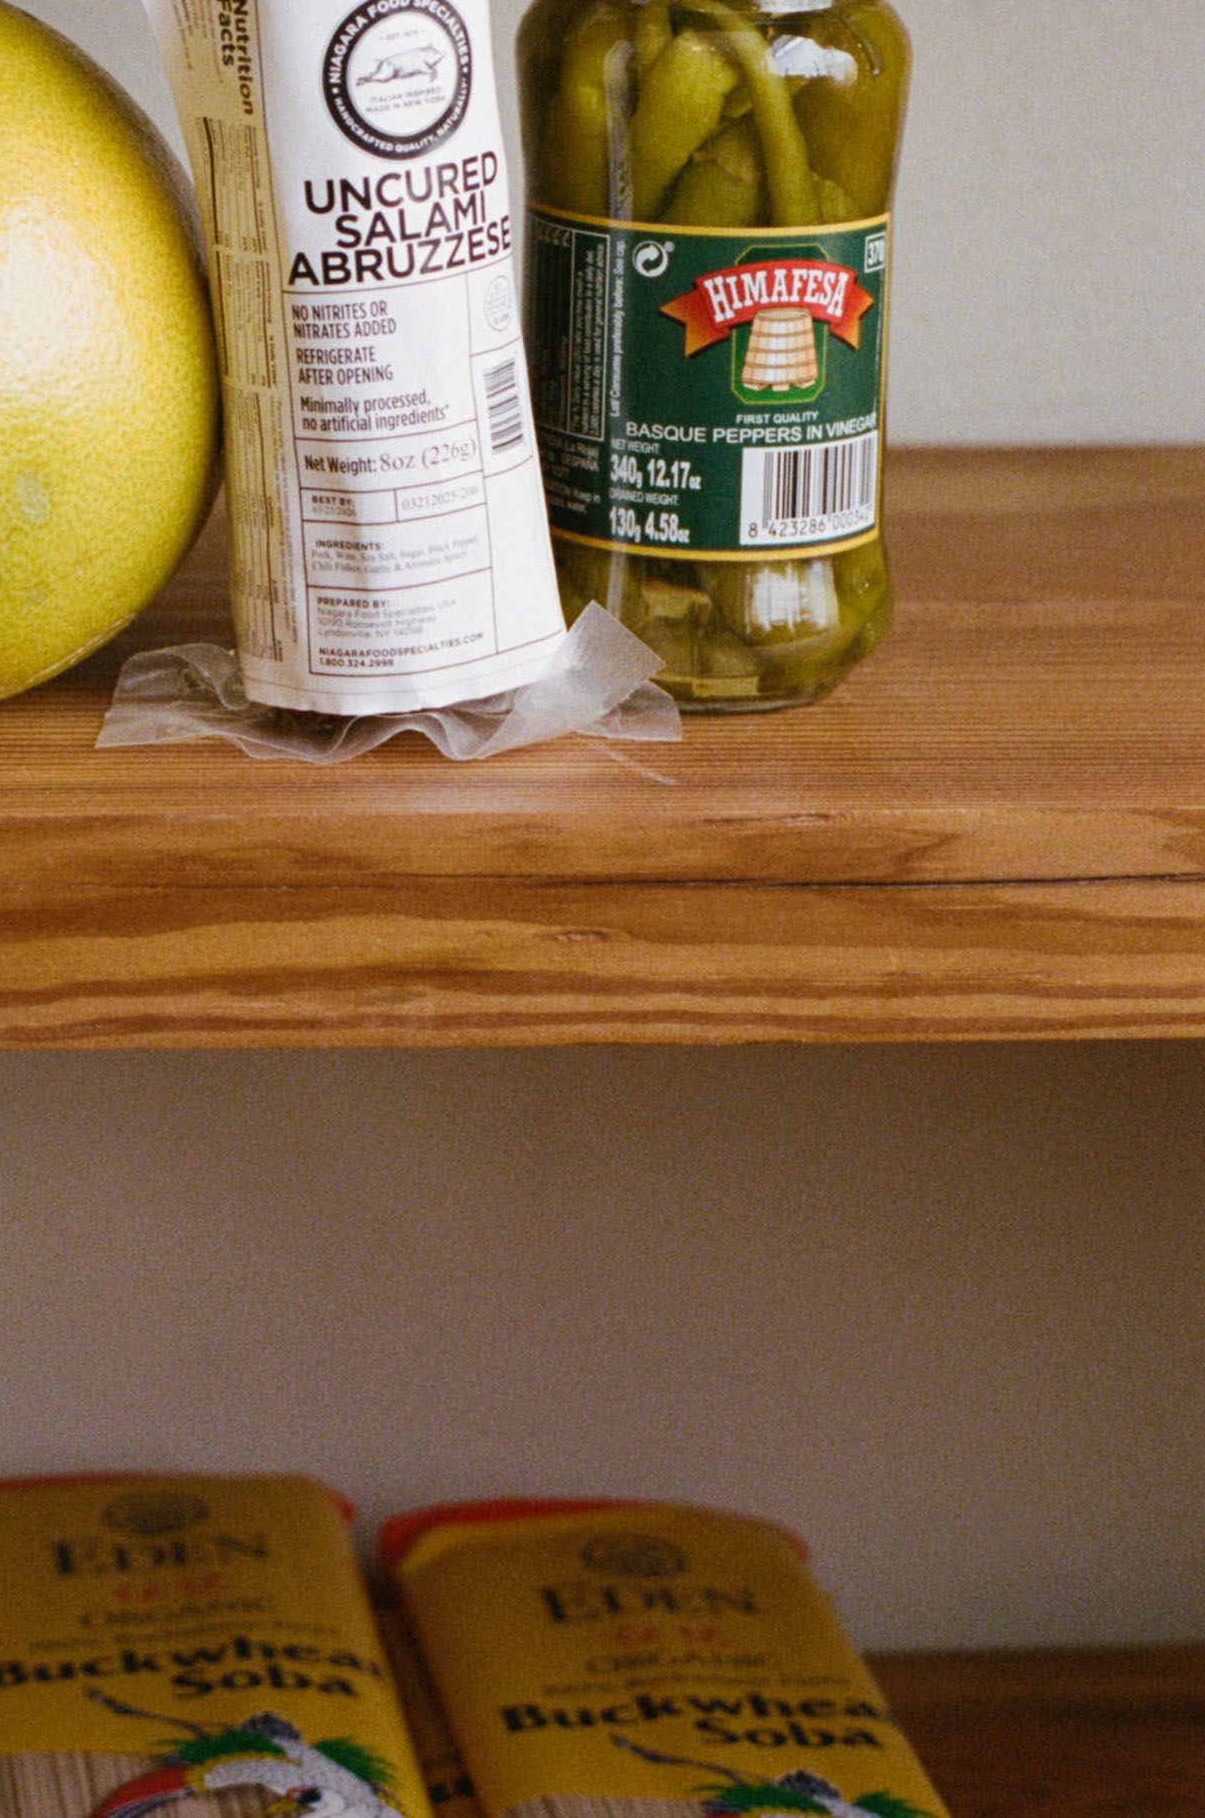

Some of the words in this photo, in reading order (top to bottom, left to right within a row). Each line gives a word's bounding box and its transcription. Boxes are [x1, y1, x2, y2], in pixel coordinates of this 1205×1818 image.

[329, 15, 368, 84] NIAGARA
[303, 150, 498, 215] UNCURED
[335, 191, 487, 249] SALAMI
[287, 213, 512, 287] ABRUZZESE
[703, 268, 850, 323] HIMAFESA
[292, 304, 309, 322] NO
[312, 301, 367, 321] NITRITES
[370, 300, 388, 318] OR
[293, 322, 351, 340] NITRATES
[354, 318, 397, 338] ADDED
[296, 346, 377, 365] REFRIGERATE
[298, 367, 334, 386] AFTER
[337, 364, 394, 385] OPENING
[300, 395, 359, 417] Minimally
[363, 388, 431, 414] processed,
[302, 417, 317, 431] no
[320, 414, 372, 432] artificial
[736, 412, 770, 424] FIRST
[773, 410, 819, 423] QUALITY
[626, 422, 706, 444] BASQUE
[712, 425, 802, 444] PEPPERS
[806, 424, 823, 440] IN
[304, 455, 325, 472] Net
[327, 456, 377, 476] Weight:
[380, 452, 416, 472] 8oz
[421, 437, 477, 470] (226g)
[610, 453, 643, 489] 340g
[647, 458, 702, 490] 12.17oz
[311, 495, 337, 506] BEST
[609, 487, 644, 503] DRAINED
[609, 505, 641, 543] 130g
[645, 510, 690, 543] 4.58oz
[748, 522, 759, 539] 8
[317, 597, 369, 609] PREPARED
[319, 632, 484, 657] NIAGARAFOODSPECIALTIES.COM
[695, 1716, 883, 1750] Soba
